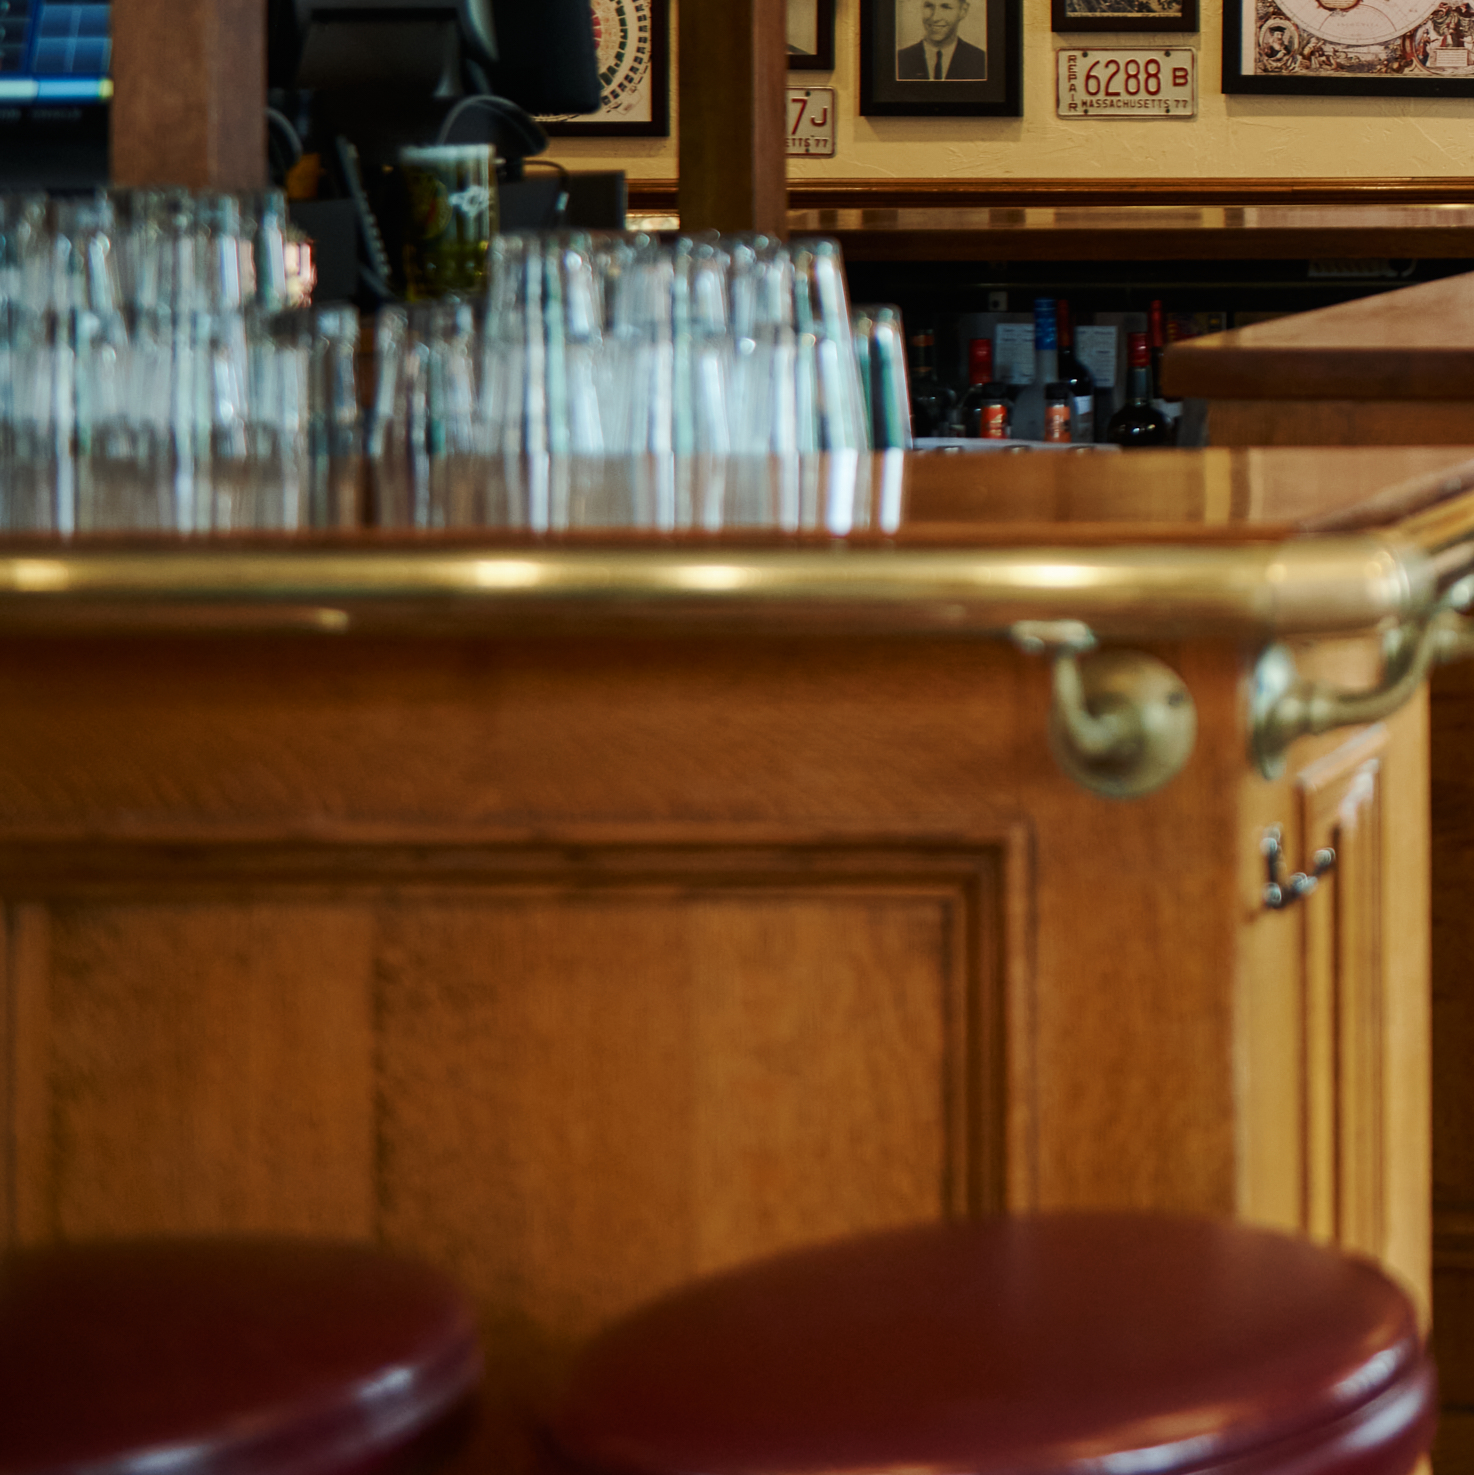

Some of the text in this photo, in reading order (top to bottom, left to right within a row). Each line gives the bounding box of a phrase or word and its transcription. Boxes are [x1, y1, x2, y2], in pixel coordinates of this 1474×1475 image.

[1067, 54, 1079, 112] REPAIR
[1084, 58, 1189, 97] 6288 B
[1081, 98, 1189, 110] MASSACHUSETTS 77
[810, 105, 829, 128] J
[814, 137, 829, 148] 77
